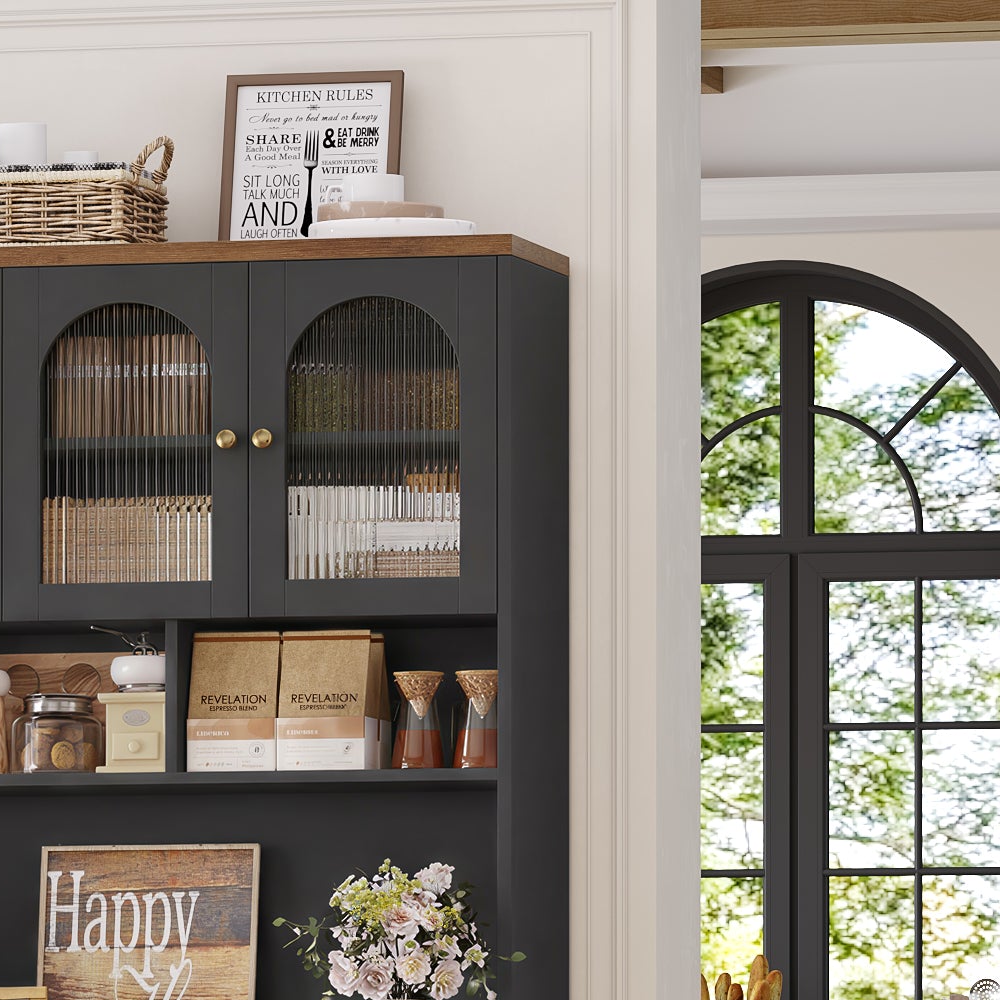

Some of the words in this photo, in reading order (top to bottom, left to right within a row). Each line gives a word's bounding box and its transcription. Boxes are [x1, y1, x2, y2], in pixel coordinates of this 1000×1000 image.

[256, 90, 322, 103] KITCHEN
[327, 88, 373, 101] RULES
[249, 112, 281, 123] Never
[282, 117, 293, 125] go
[296, 114, 303, 122] to
[306, 113, 319, 121] bed
[321, 113, 339, 121] mad
[351, 111, 378, 123] hungry
[337, 127, 353, 138] EAT
[355, 126, 380, 137] DRINK
[245, 133, 302, 146] SHARE
[337, 137, 347, 148] BE
[350, 137, 379, 148] MERRY
[246, 145, 264, 153] Each
[266, 145, 280, 153] Day
[254, 153, 276, 161] Good
[321, 166, 349, 174] WITH
[351, 165, 378, 174] LOVE
[243, 174, 262, 188] SIT
[265, 173, 300, 188] LONG
[242, 189, 266, 200] TALK
[269, 188, 300, 200] MUCH
[241, 201, 298, 227] AND
[240, 229, 268, 239] LAUGH
[270, 228, 298, 238] OFTEN
[200, 694, 267, 705] REVELATION
[290, 693, 358, 704] REVELATION
[45, 870, 200, 979] Happy
